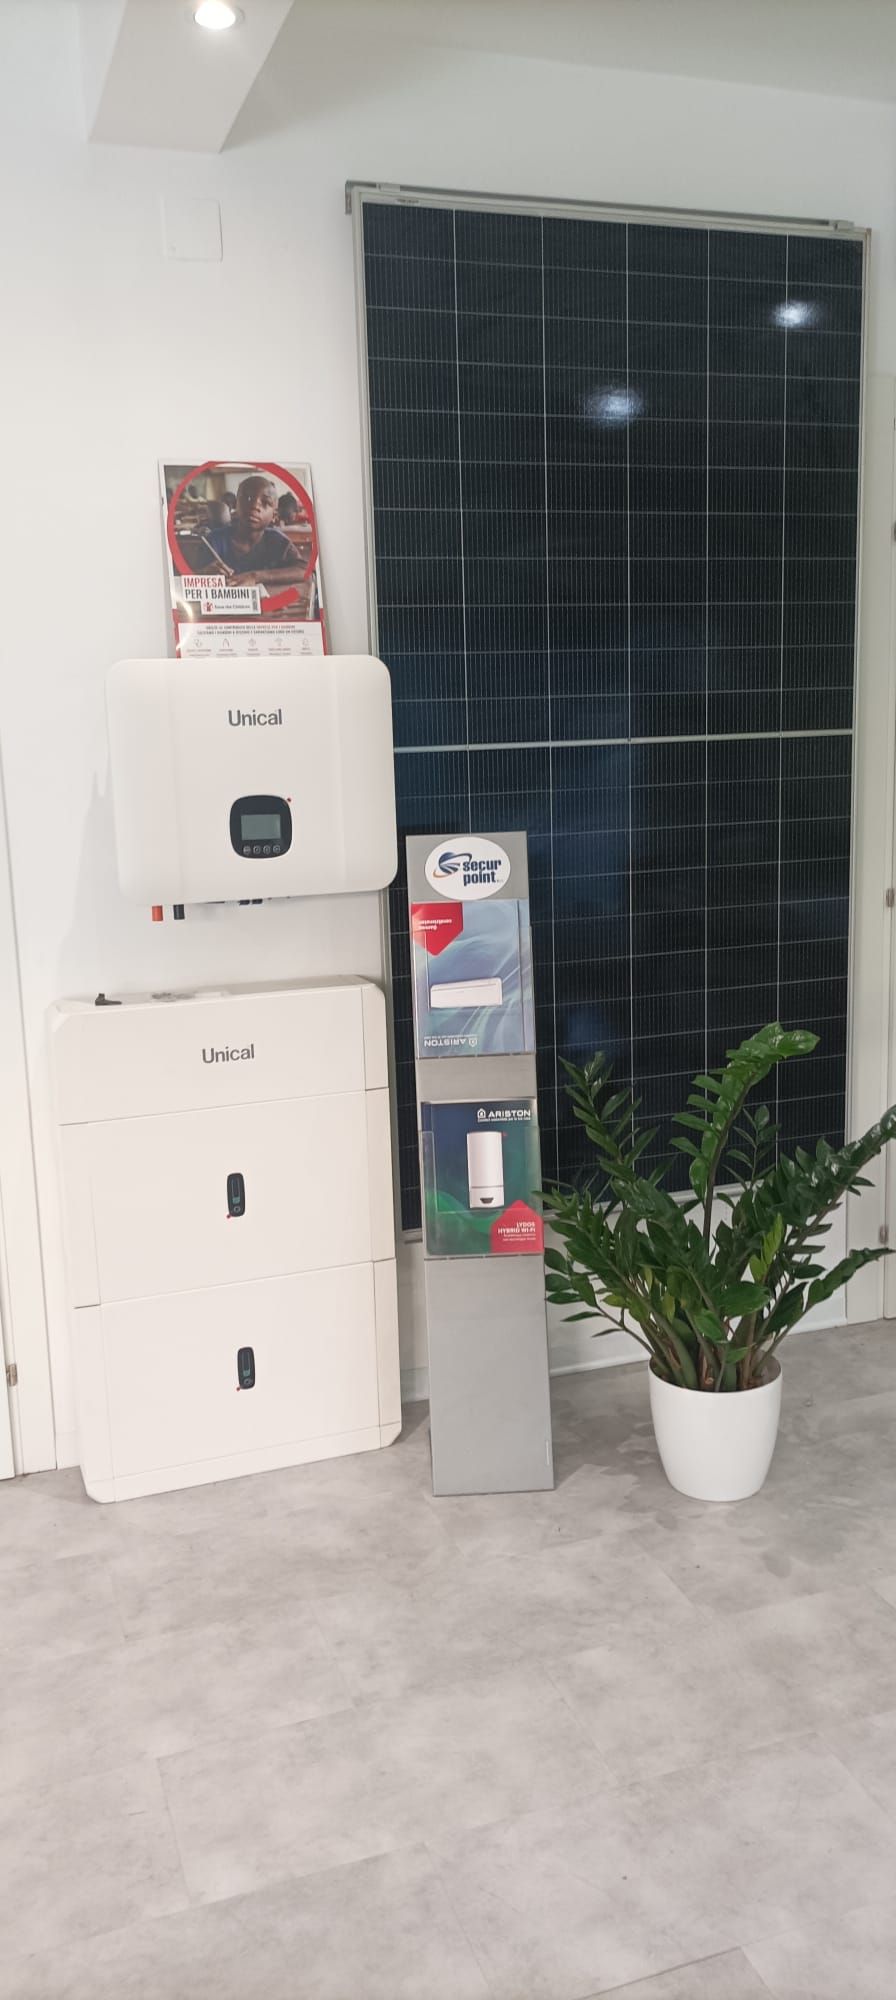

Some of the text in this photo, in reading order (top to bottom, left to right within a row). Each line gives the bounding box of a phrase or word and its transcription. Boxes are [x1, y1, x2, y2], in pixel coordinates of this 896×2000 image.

[183, 577, 223, 588] IMPRESA
[185, 588, 250, 600] PER I BAMBINI
[228, 708, 283, 727] Unical
[462, 859, 502, 872] secur
[463, 871, 496, 887] point
[424, 1038, 467, 1047] ARISTON
[202, 1043, 254, 1063] Unical
[488, 1109, 531, 1118] ARISTON
